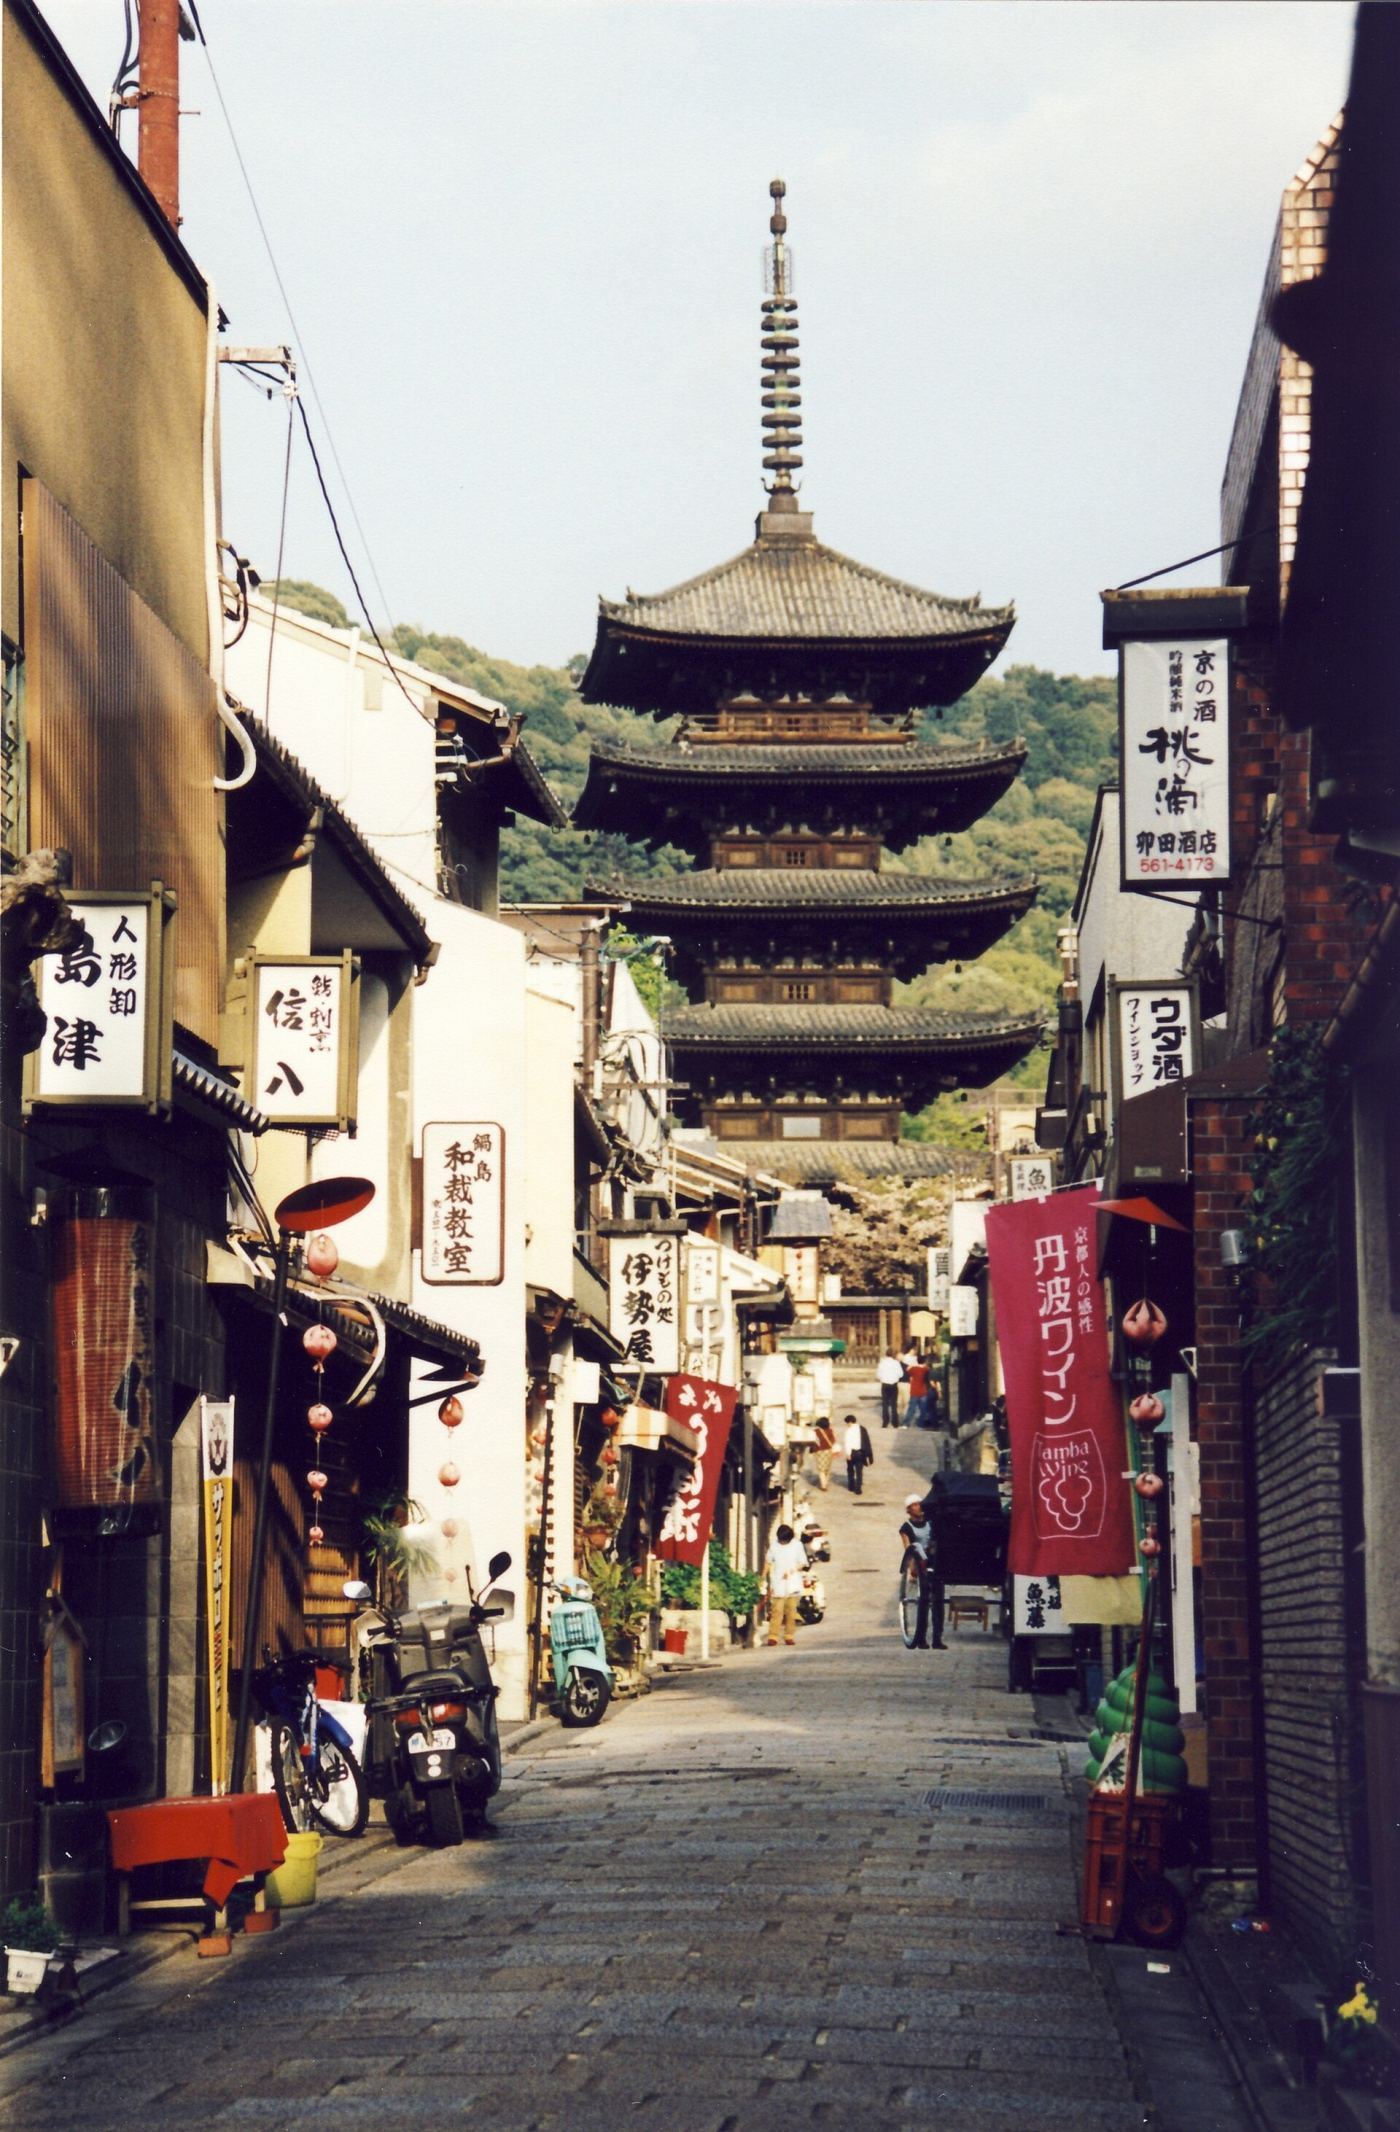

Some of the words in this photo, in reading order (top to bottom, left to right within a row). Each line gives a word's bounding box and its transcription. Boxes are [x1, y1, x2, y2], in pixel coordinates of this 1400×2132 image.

[1193, 649, 1217, 723] 京の酒
[1140, 856, 1215, 873] 561-4173
[109, 915, 138, 1017] 人形卸
[265, 987, 307, 1097] 信八
[1126, 998, 1144, 1085] ワインショップ
[472, 1133, 492, 1183] 鍋島
[443, 1141, 475, 1275] 和裁教室
[621, 1252, 655, 1364] 伊勢屋
[654, 1239, 674, 1324] つけもの処
[1073, 1226, 1094, 1334] 京都人の感性
[1033, 1234, 1076, 1425] 丹波ワイン
[1036, 1439, 1089, 1460] Tamba
[1038, 1460, 1088, 1479] Wine
